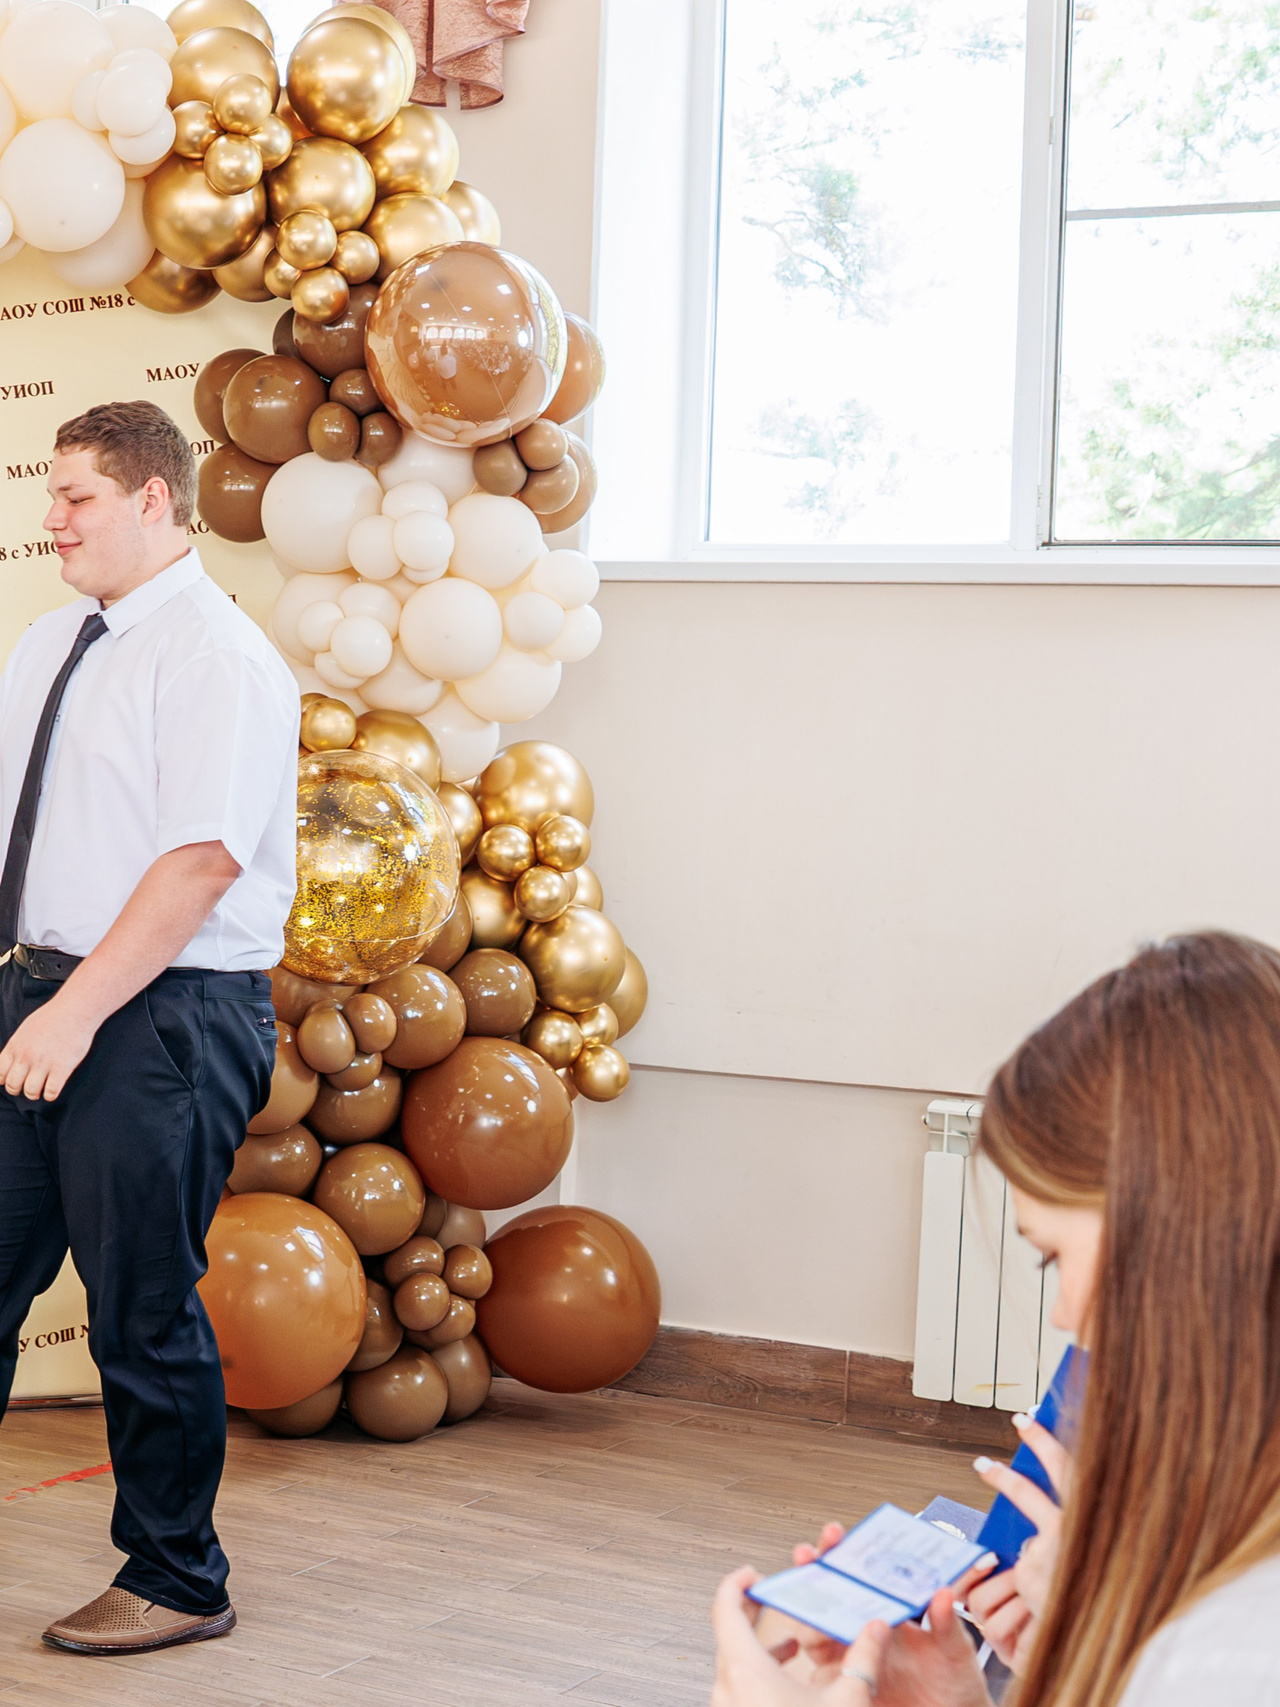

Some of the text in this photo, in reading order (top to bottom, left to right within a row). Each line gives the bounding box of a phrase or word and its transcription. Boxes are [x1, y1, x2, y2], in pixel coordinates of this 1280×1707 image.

[42, 297, 86, 316] СОШ
[88, 293, 124, 311] №18
[126, 294, 136, 307] с
[146, 362, 200, 383] МАОУ
[0, 380, 54, 401] УИОП
[192, 439, 215, 457] ОП
[6, 460, 53, 480] МАО
[11, 549, 19, 560] с
[34, 1326, 76, 1349] СОШ
